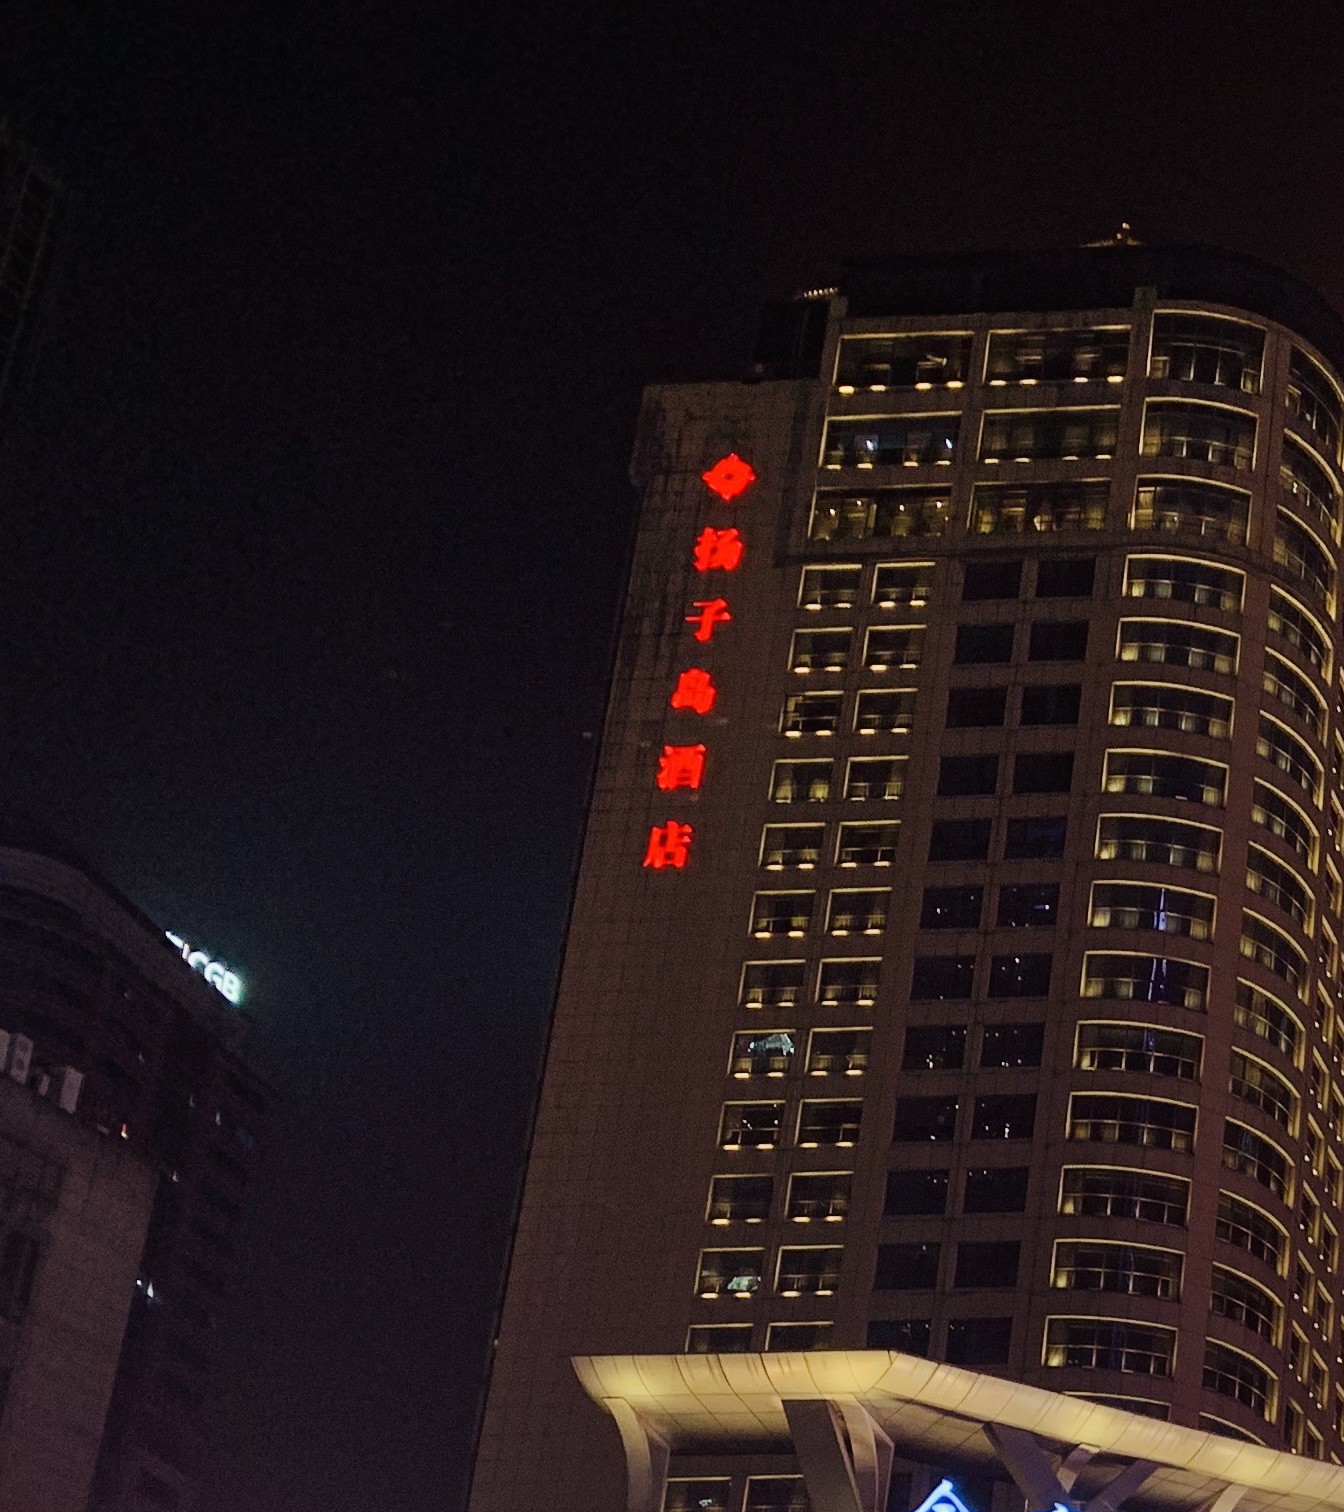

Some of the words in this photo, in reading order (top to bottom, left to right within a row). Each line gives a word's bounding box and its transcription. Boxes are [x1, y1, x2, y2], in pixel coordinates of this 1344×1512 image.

[643, 527, 744, 868] 扬子岛酒店
